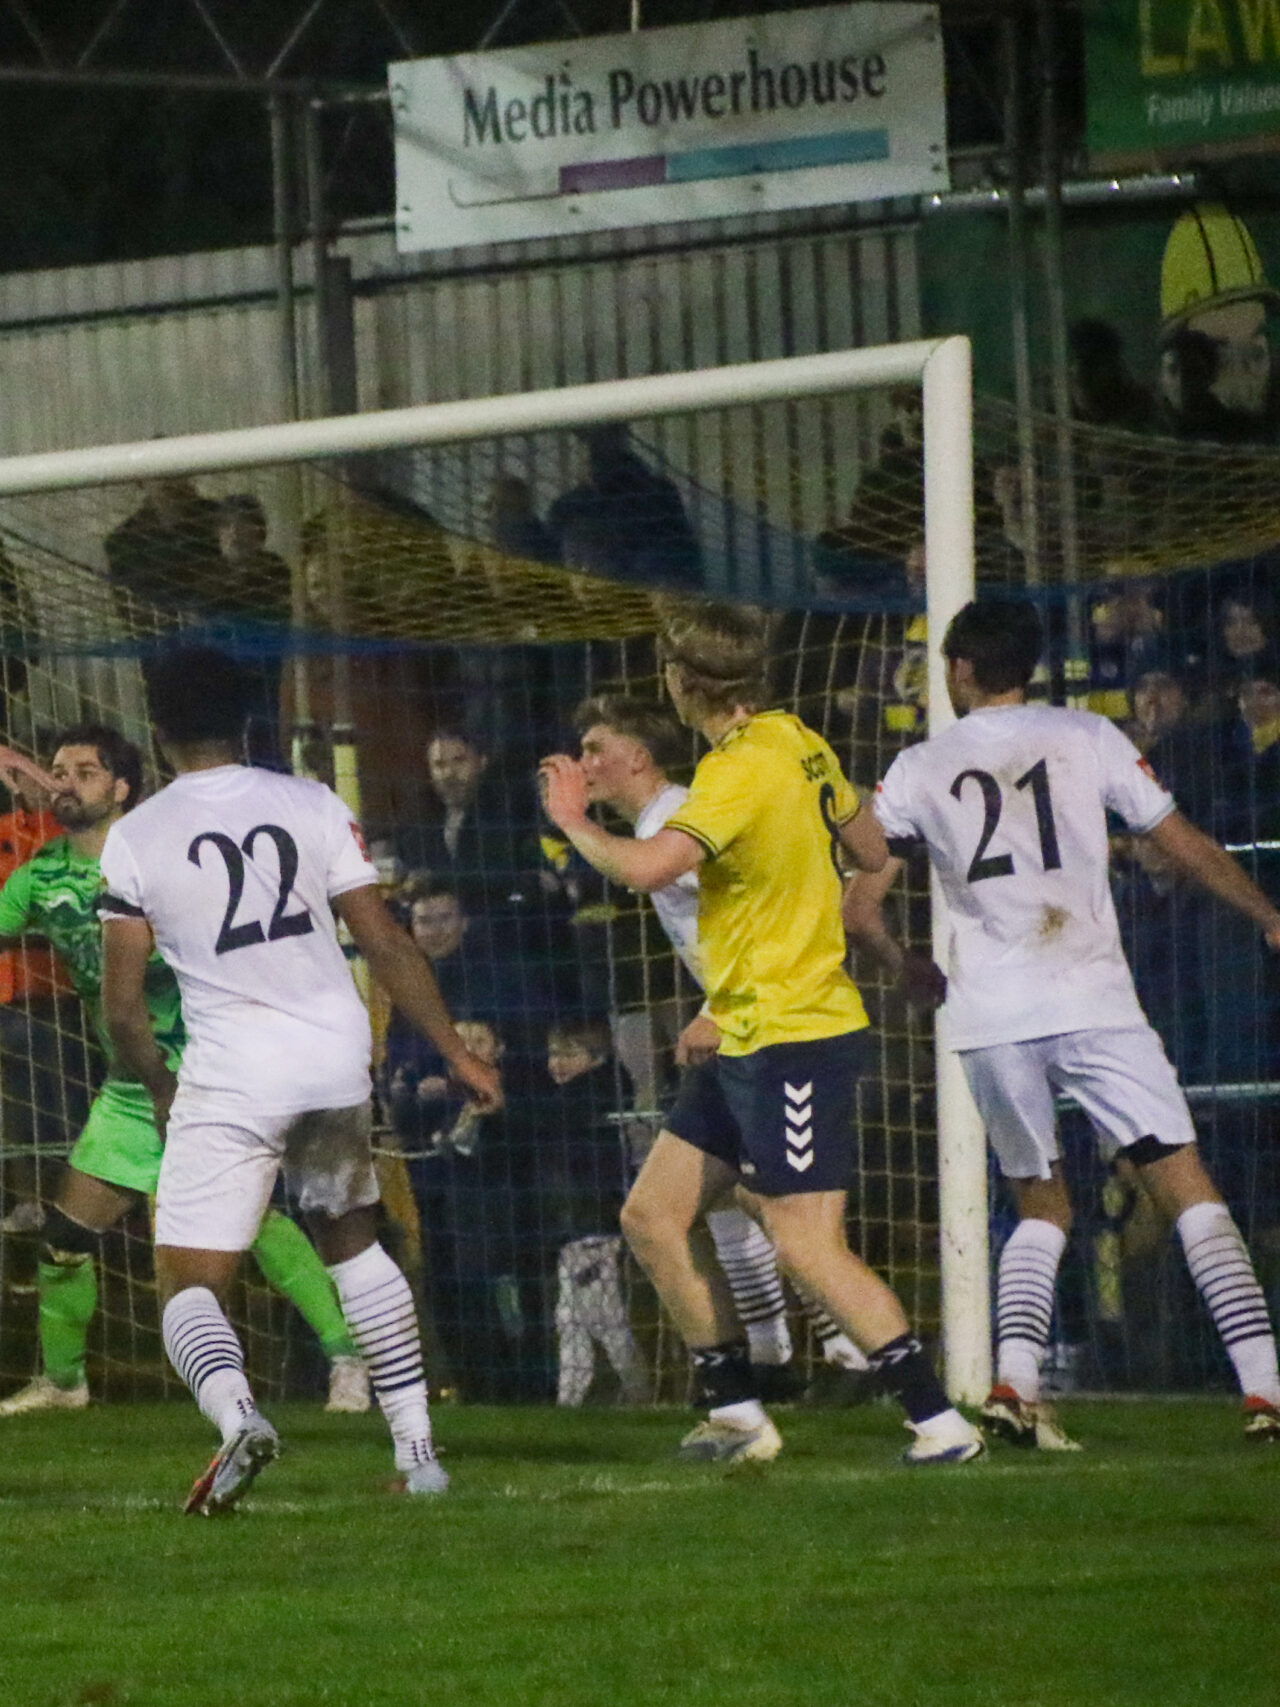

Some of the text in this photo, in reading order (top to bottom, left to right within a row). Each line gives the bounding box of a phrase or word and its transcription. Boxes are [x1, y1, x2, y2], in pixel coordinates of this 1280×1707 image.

[463, 48, 887, 147] Media Powerhouse
[1147, 88, 1214, 127] Family
[950, 759, 1064, 884] 21
[187, 823, 313, 955] 22
